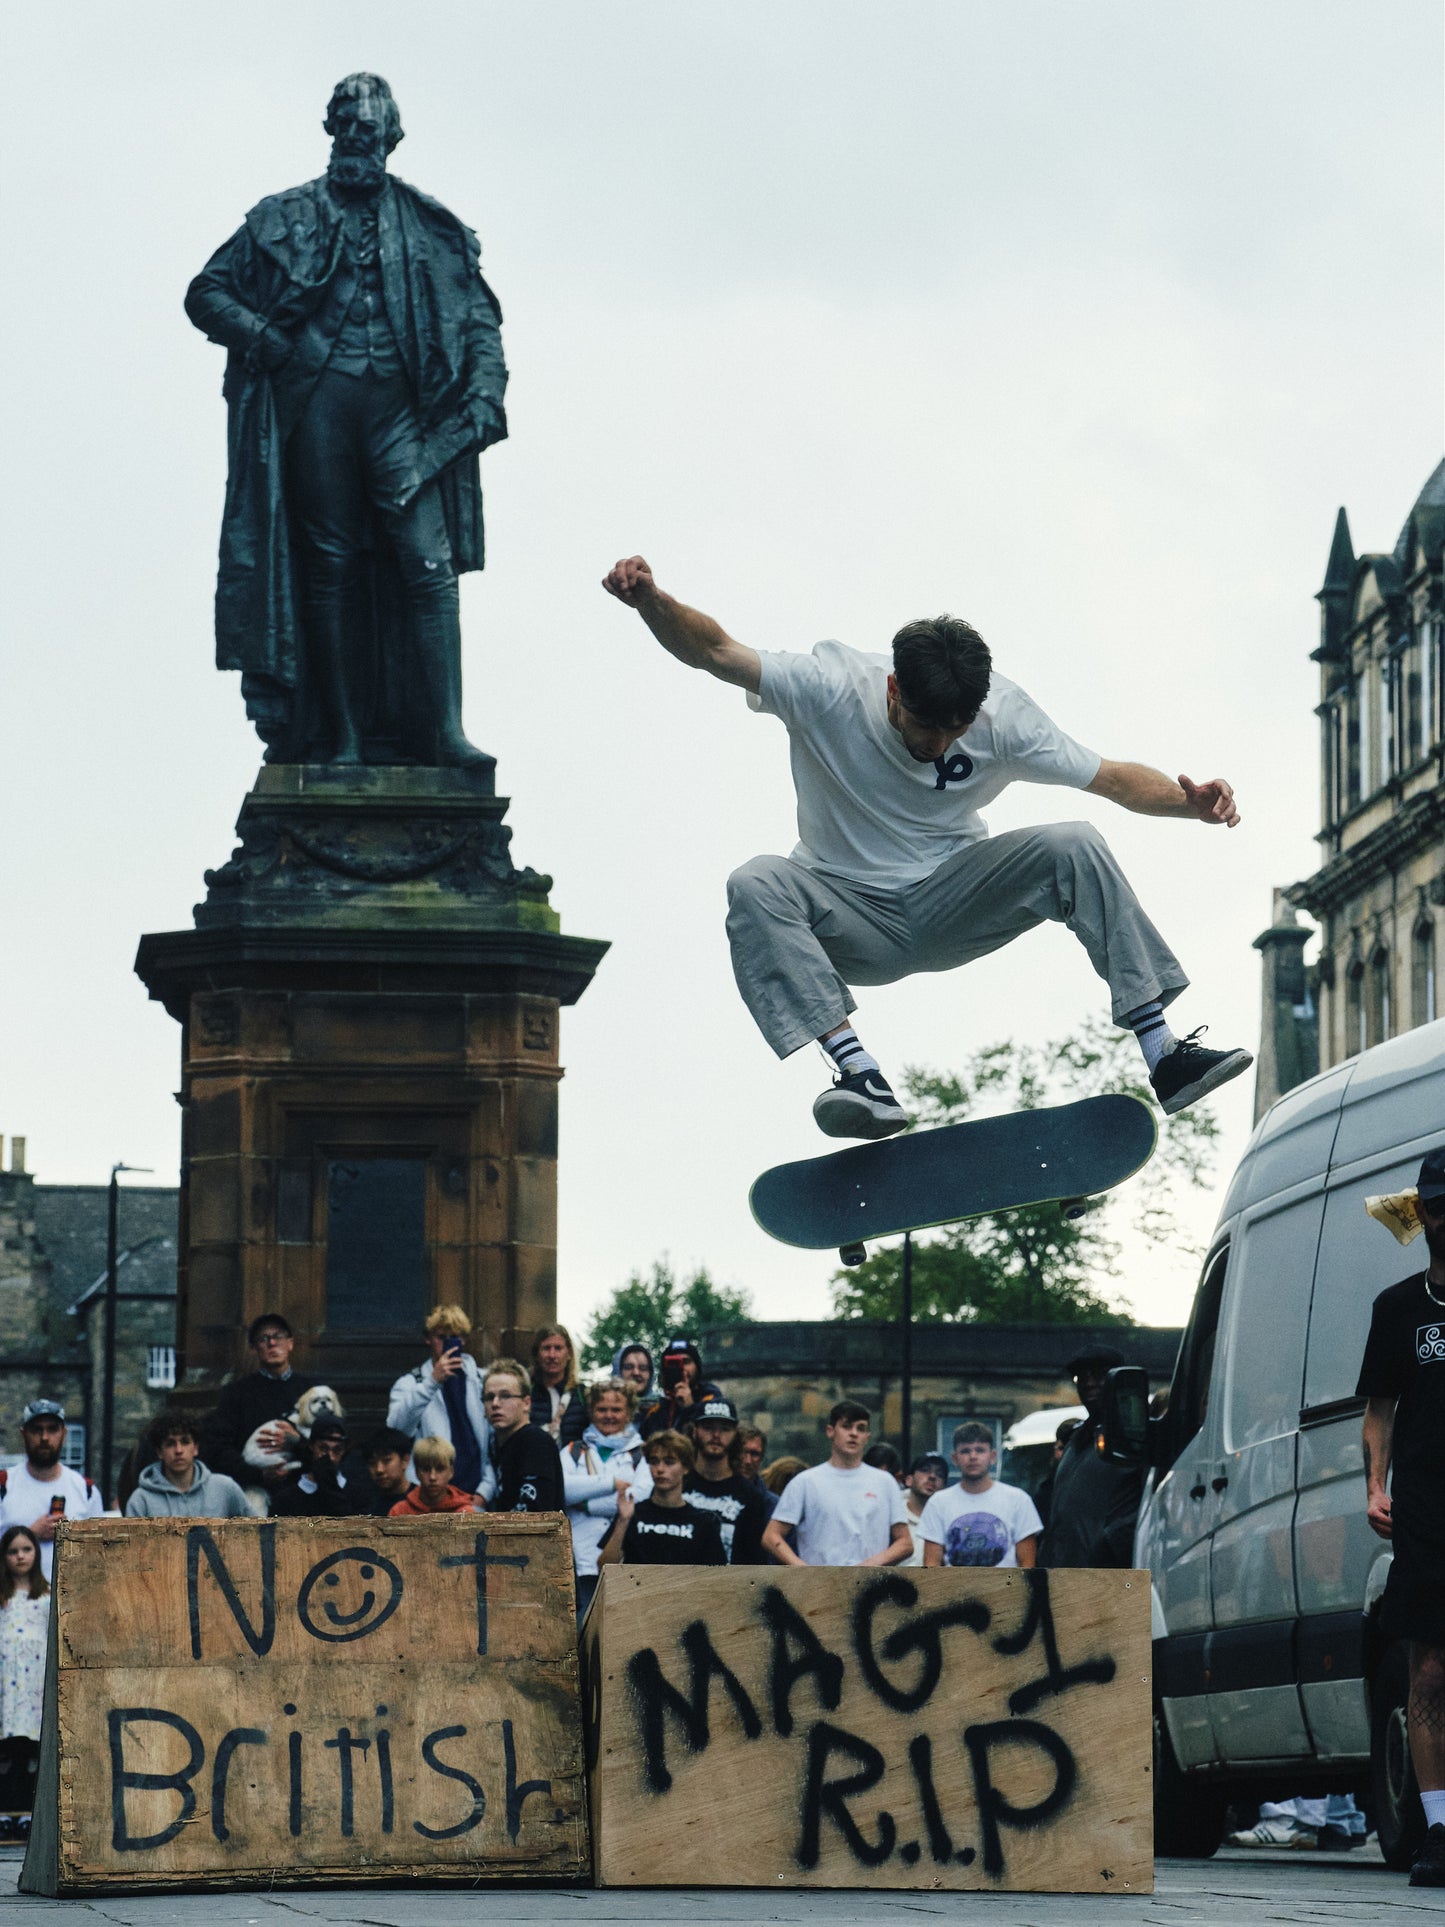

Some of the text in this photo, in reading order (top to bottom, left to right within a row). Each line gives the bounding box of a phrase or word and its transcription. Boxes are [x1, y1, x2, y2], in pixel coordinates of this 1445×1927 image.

[637, 1521, 694, 1539] freak
[108, 1703, 554, 1851] British
[797, 1719, 1077, 1878] R.I.P
